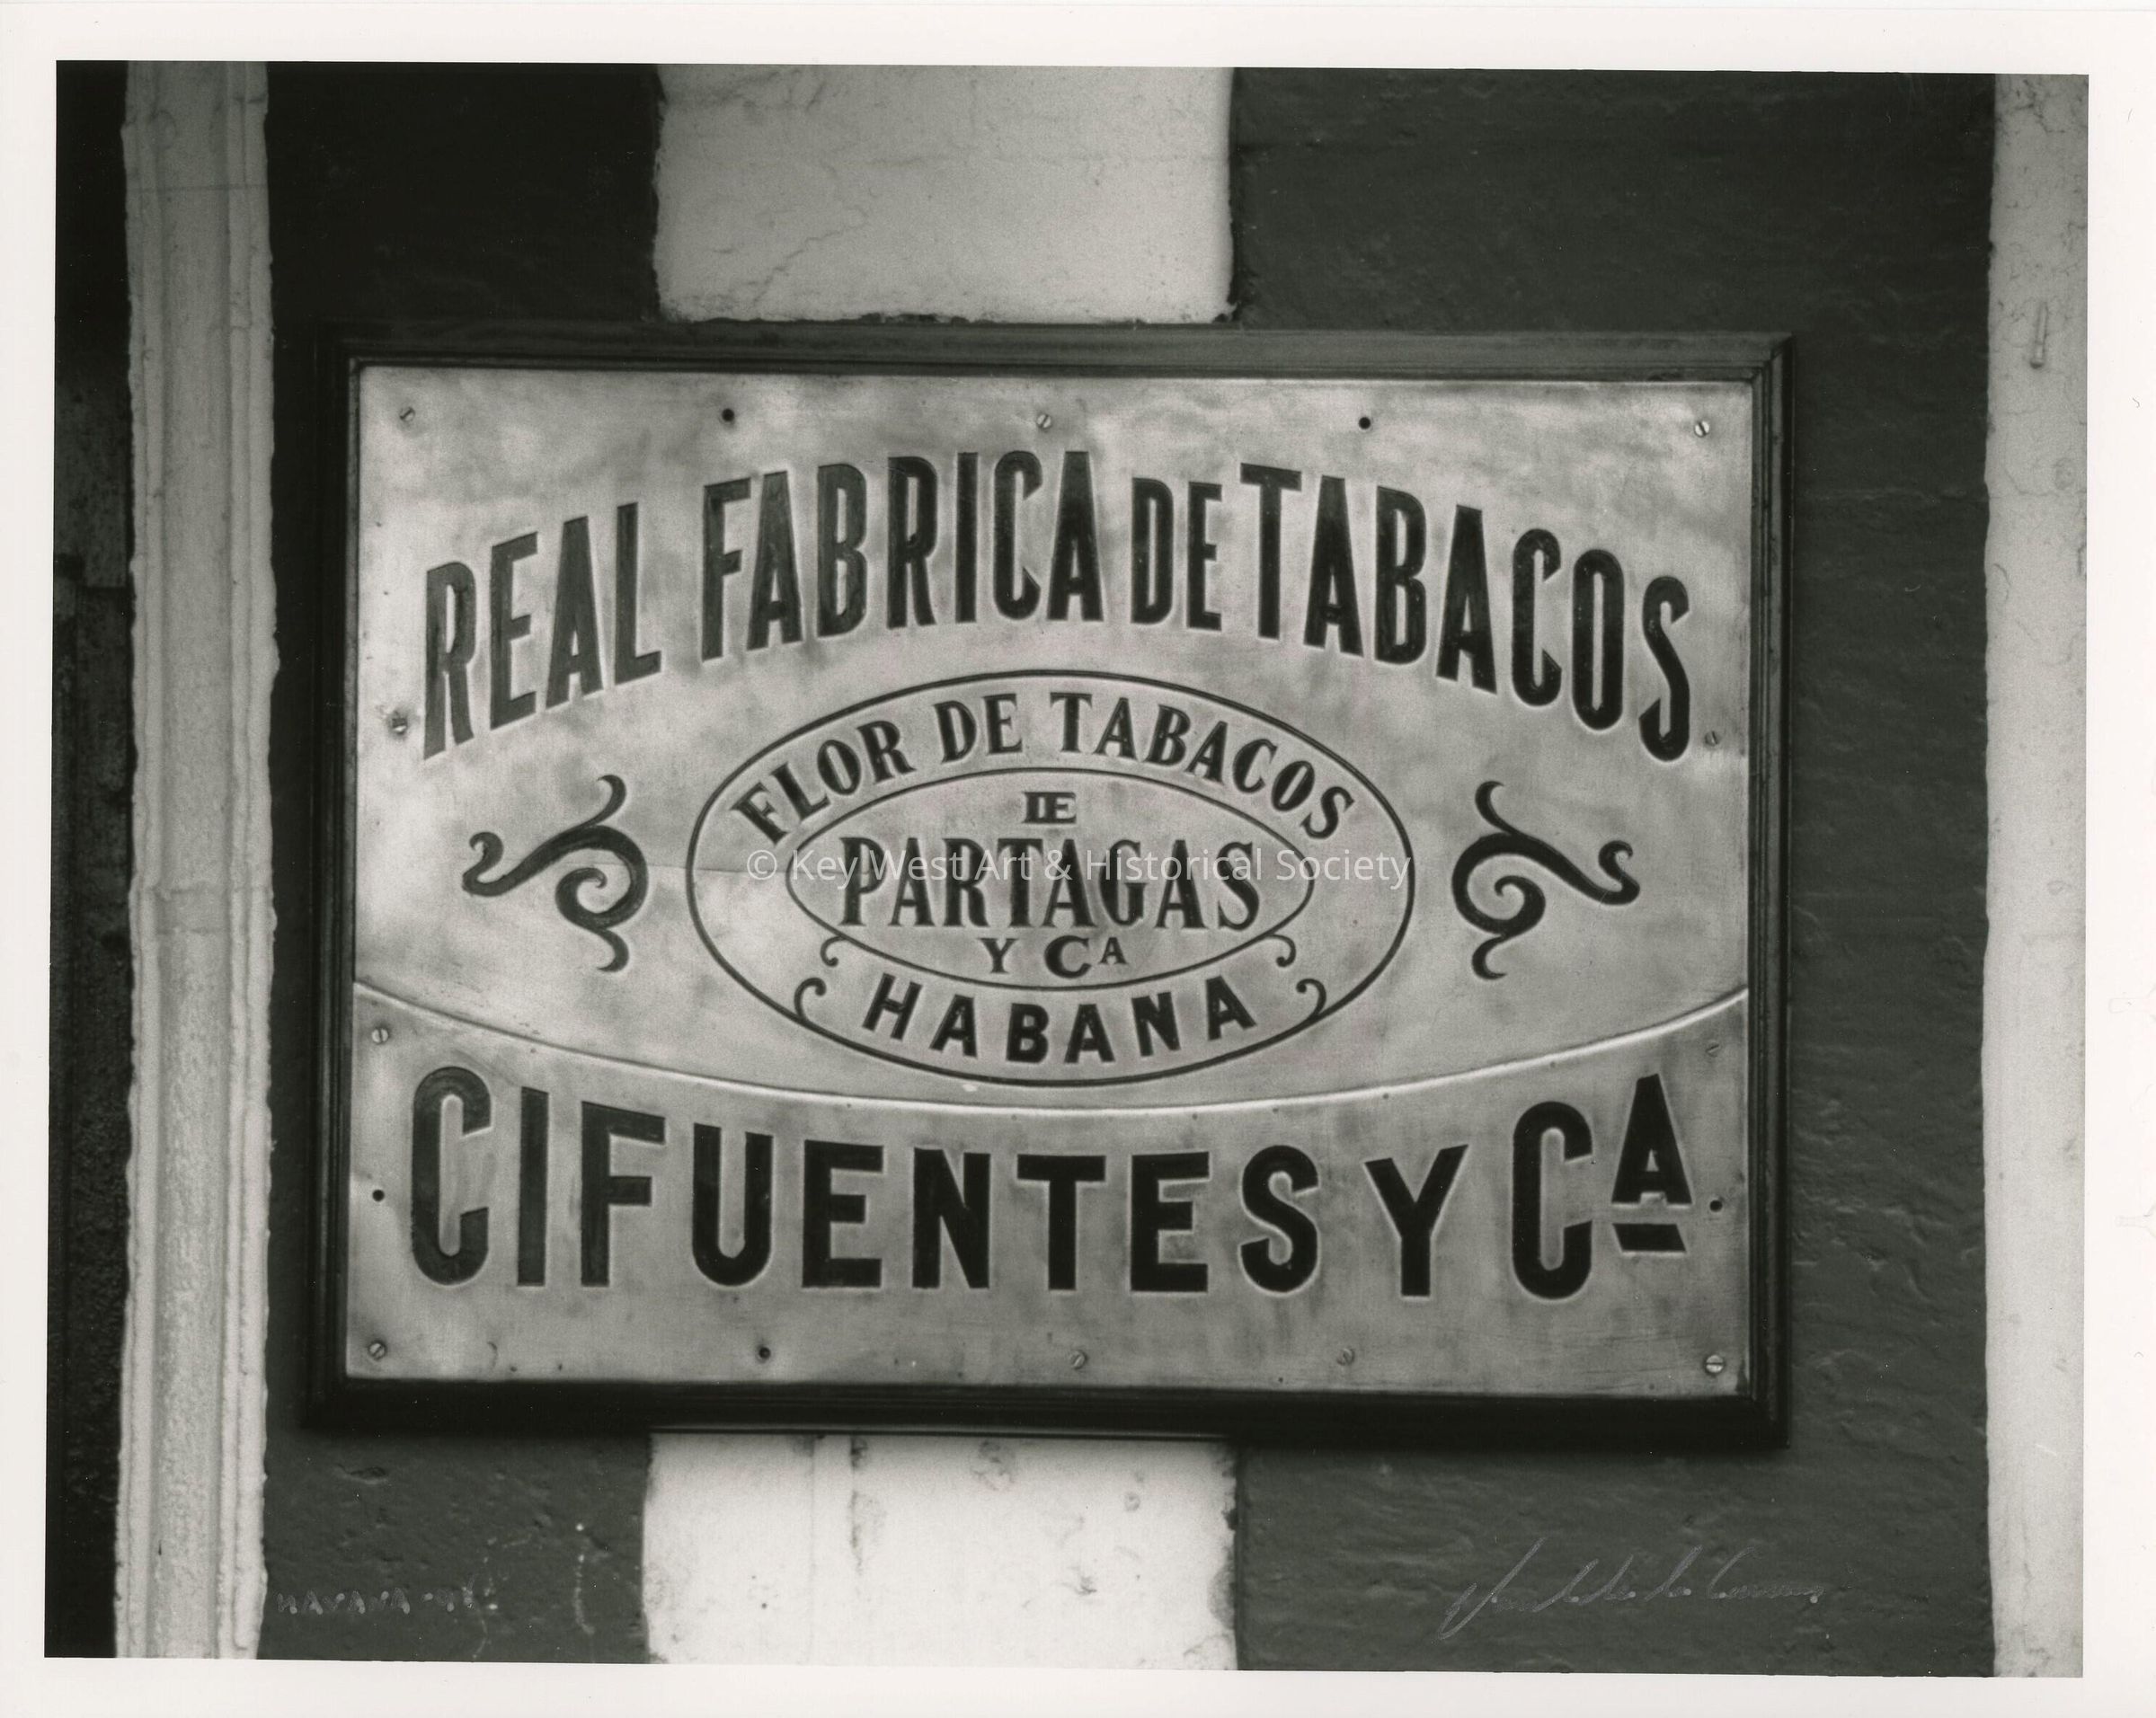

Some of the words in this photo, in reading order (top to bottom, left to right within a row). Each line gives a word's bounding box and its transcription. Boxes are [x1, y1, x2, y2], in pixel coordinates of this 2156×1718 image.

[423, 500, 662, 761] REAL
[701, 449, 1105, 662] FABRICA
[1130, 477, 1222, 631] DE
[1239, 462, 1690, 762] TABACOS
[729, 718, 916, 846] FLOR
[933, 693, 1023, 764] DE
[1050, 692, 1355, 839] TABACOS
[838, 837, 1260, 929] PARTAGAS
[977, 938, 1016, 974] Y
[863, 973, 1257, 1066] HABANA
[410, 1067, 1322, 1293] CIFUENTES
[1364, 1143, 1470, 1297] Y
